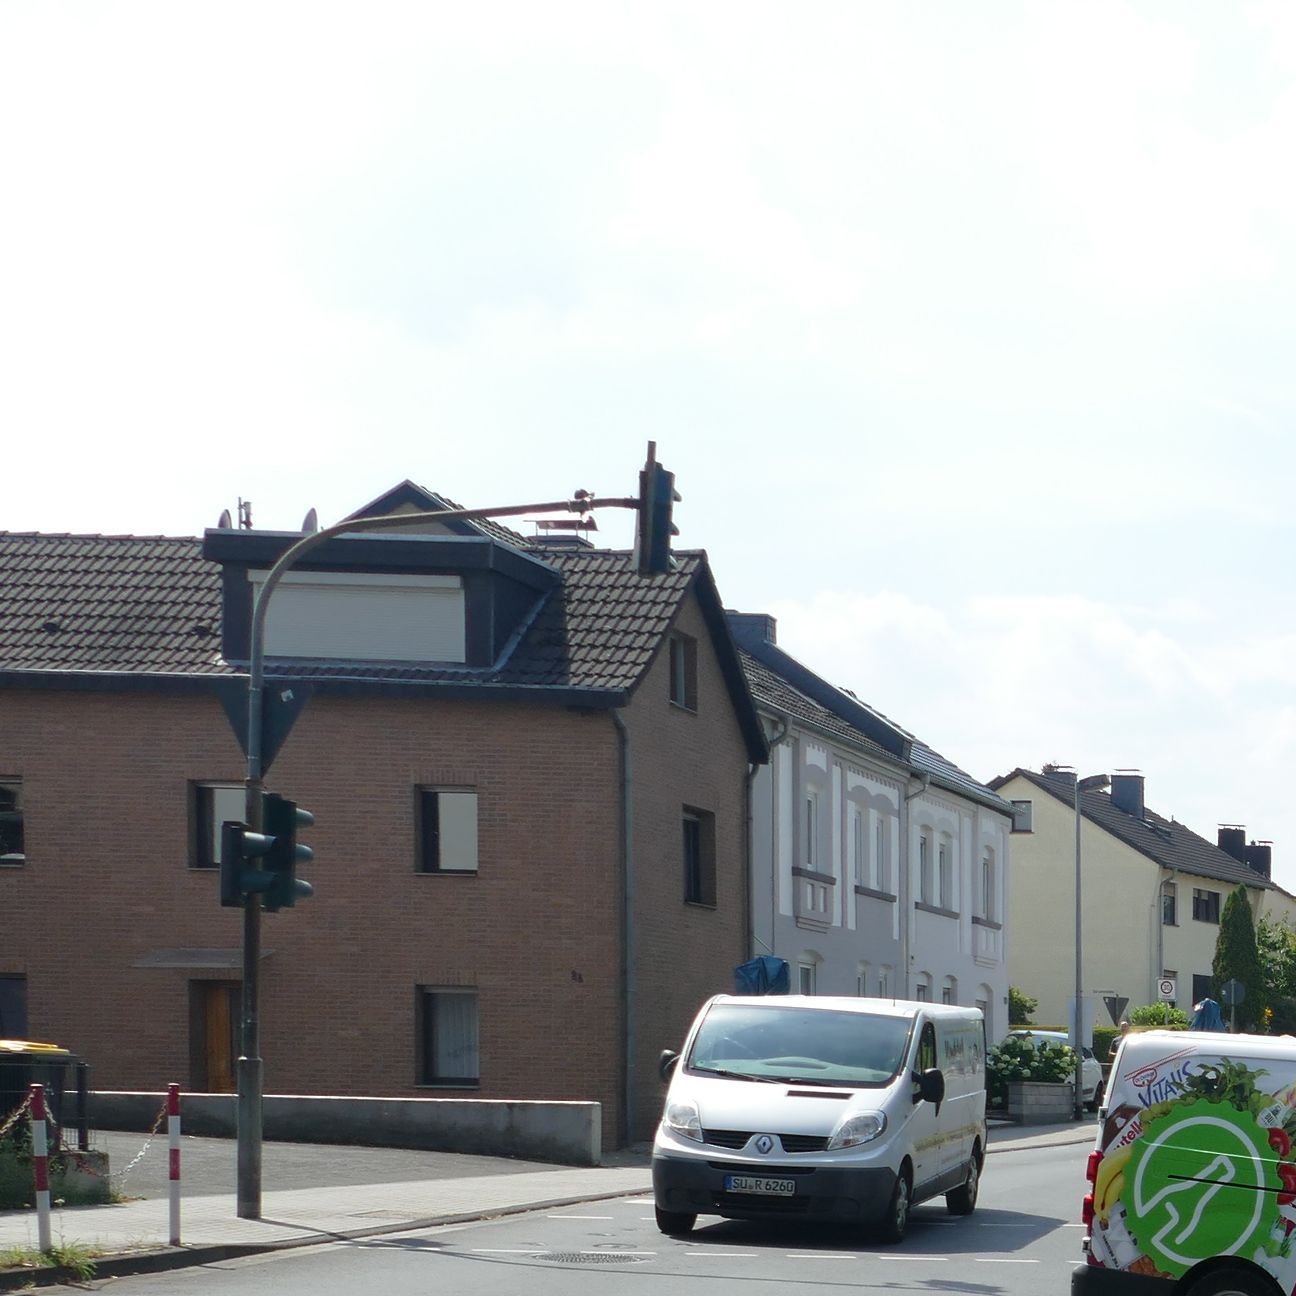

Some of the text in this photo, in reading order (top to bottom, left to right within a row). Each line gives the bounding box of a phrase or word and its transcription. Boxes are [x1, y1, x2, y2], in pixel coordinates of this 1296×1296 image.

[733, 1178, 793, 1192] SU R 6260
